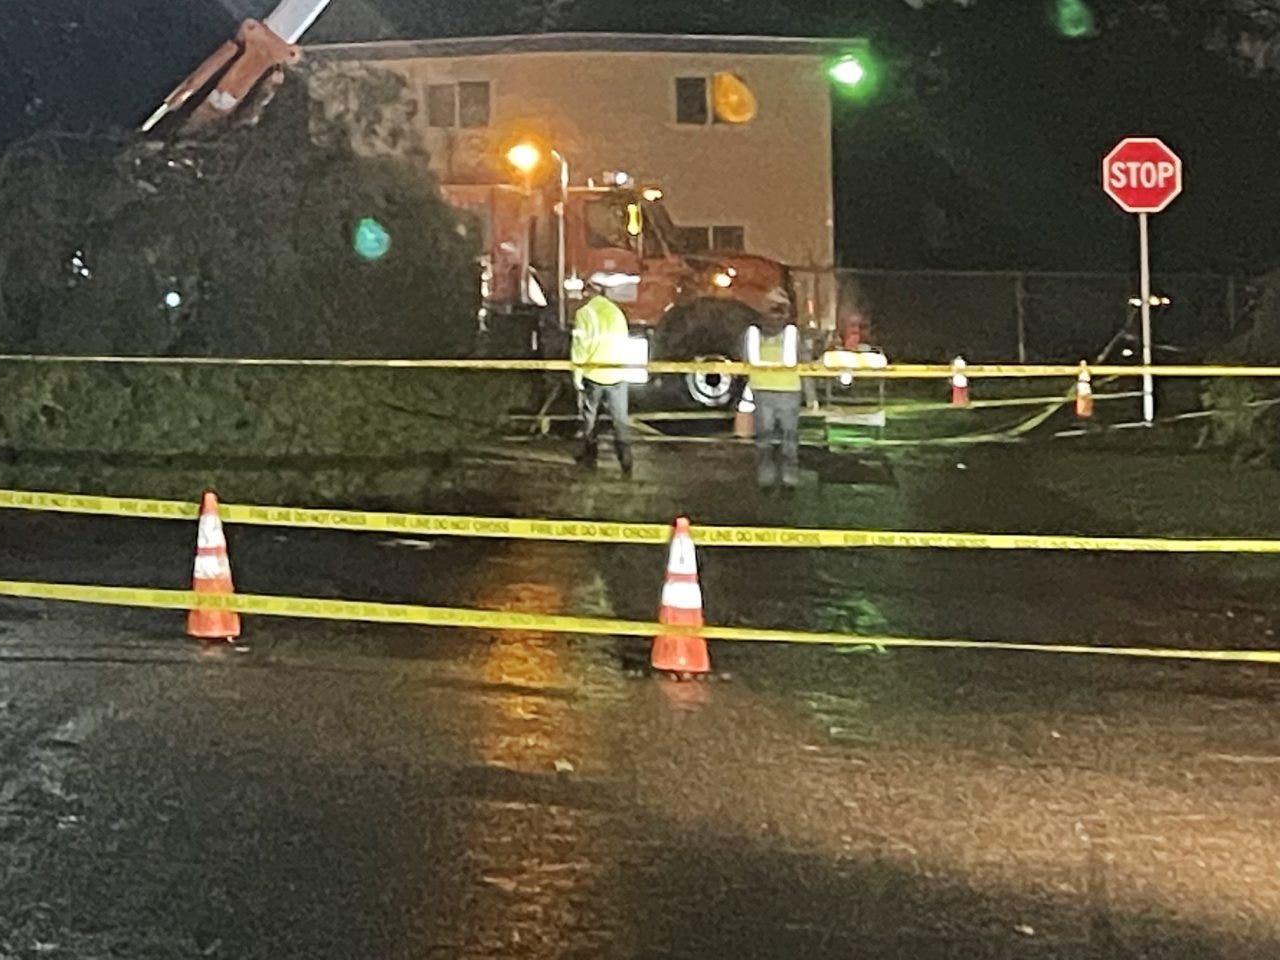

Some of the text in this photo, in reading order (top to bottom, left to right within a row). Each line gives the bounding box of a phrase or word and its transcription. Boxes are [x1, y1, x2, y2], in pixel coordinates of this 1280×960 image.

[1111, 161, 1174, 189] STOP
[555, 524, 578, 536] LINE
[580, 525, 597, 537] DO
[598, 526, 620, 537] NOT
[622, 527, 661, 539] CROSS
[735, 530, 752, 542] DO
[780, 532, 820, 545] CROSS
